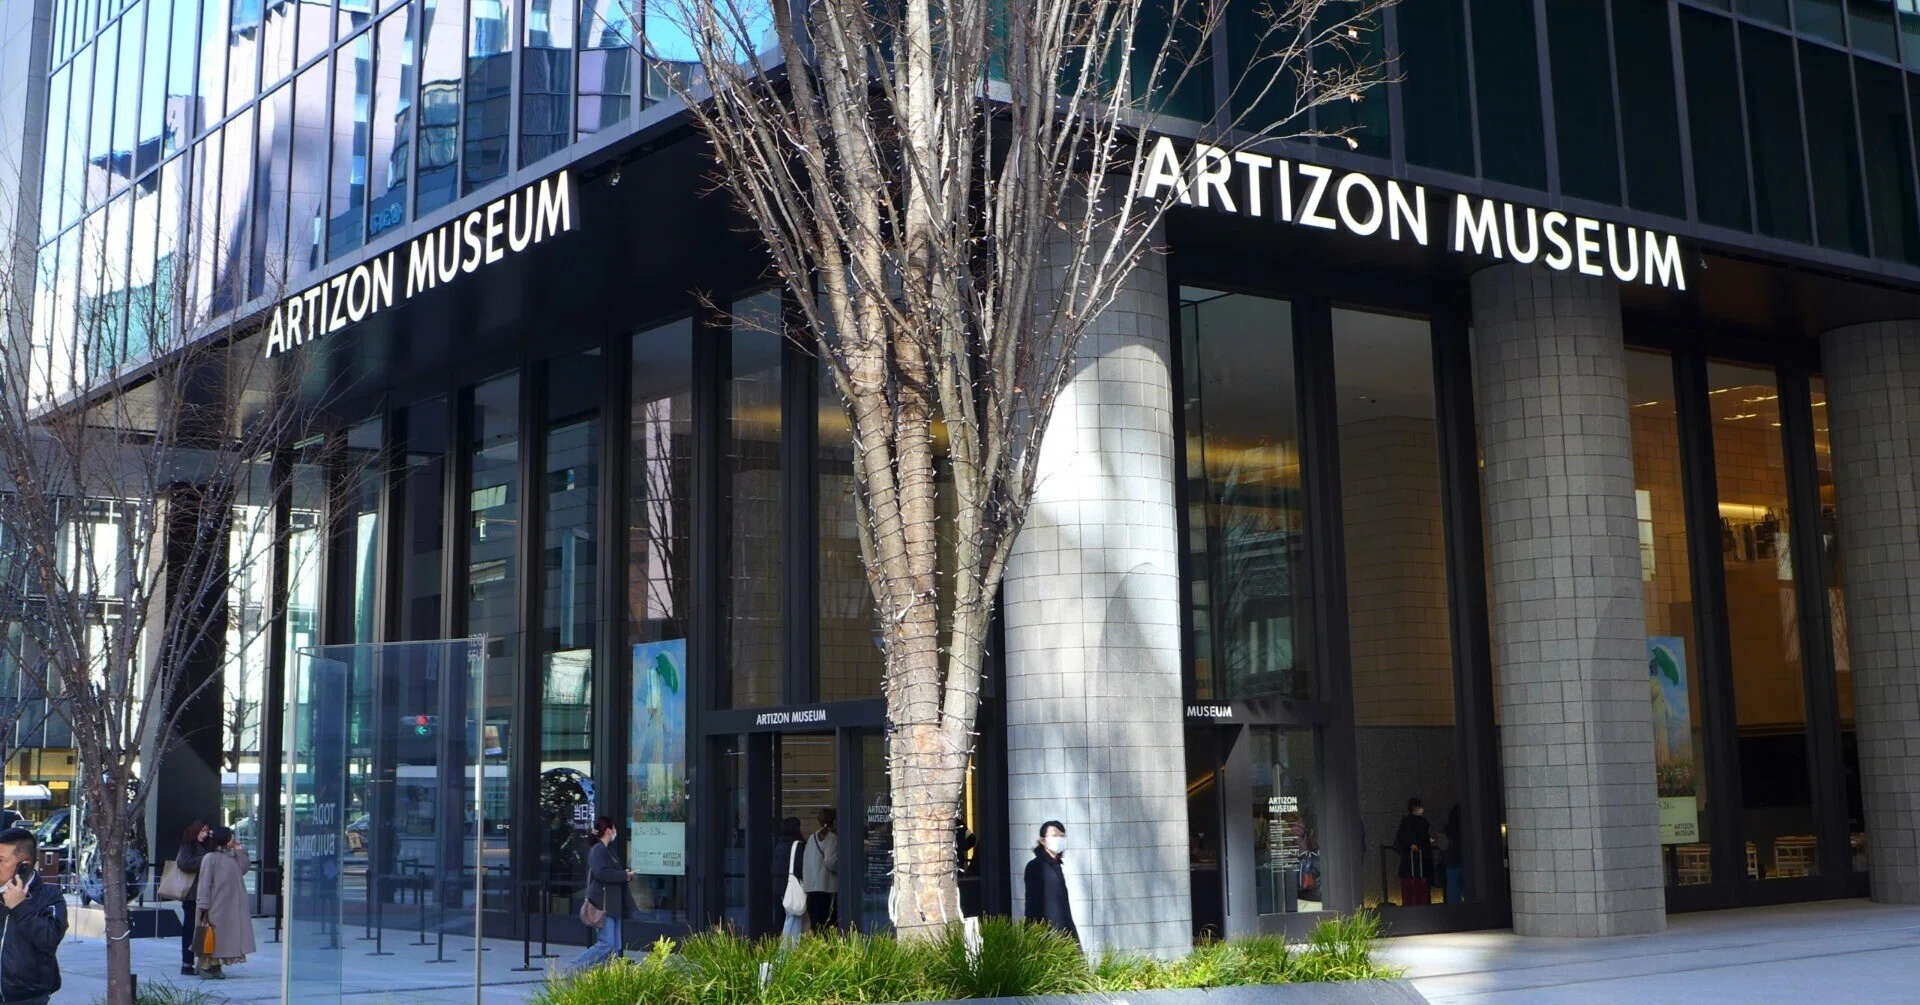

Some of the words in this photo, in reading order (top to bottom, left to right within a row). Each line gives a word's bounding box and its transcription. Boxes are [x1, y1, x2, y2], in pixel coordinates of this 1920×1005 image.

[1139, 136, 1428, 246] ARTIZON
[1452, 194, 1687, 291] MUSEUM
[265, 251, 395, 358] ARTIZON
[405, 169, 571, 298] MUSEUM
[756, 712, 790, 725] ARTIZON
[791, 709, 827, 723] MUSEUM
[1186, 705, 1232, 717] MUSEUM
